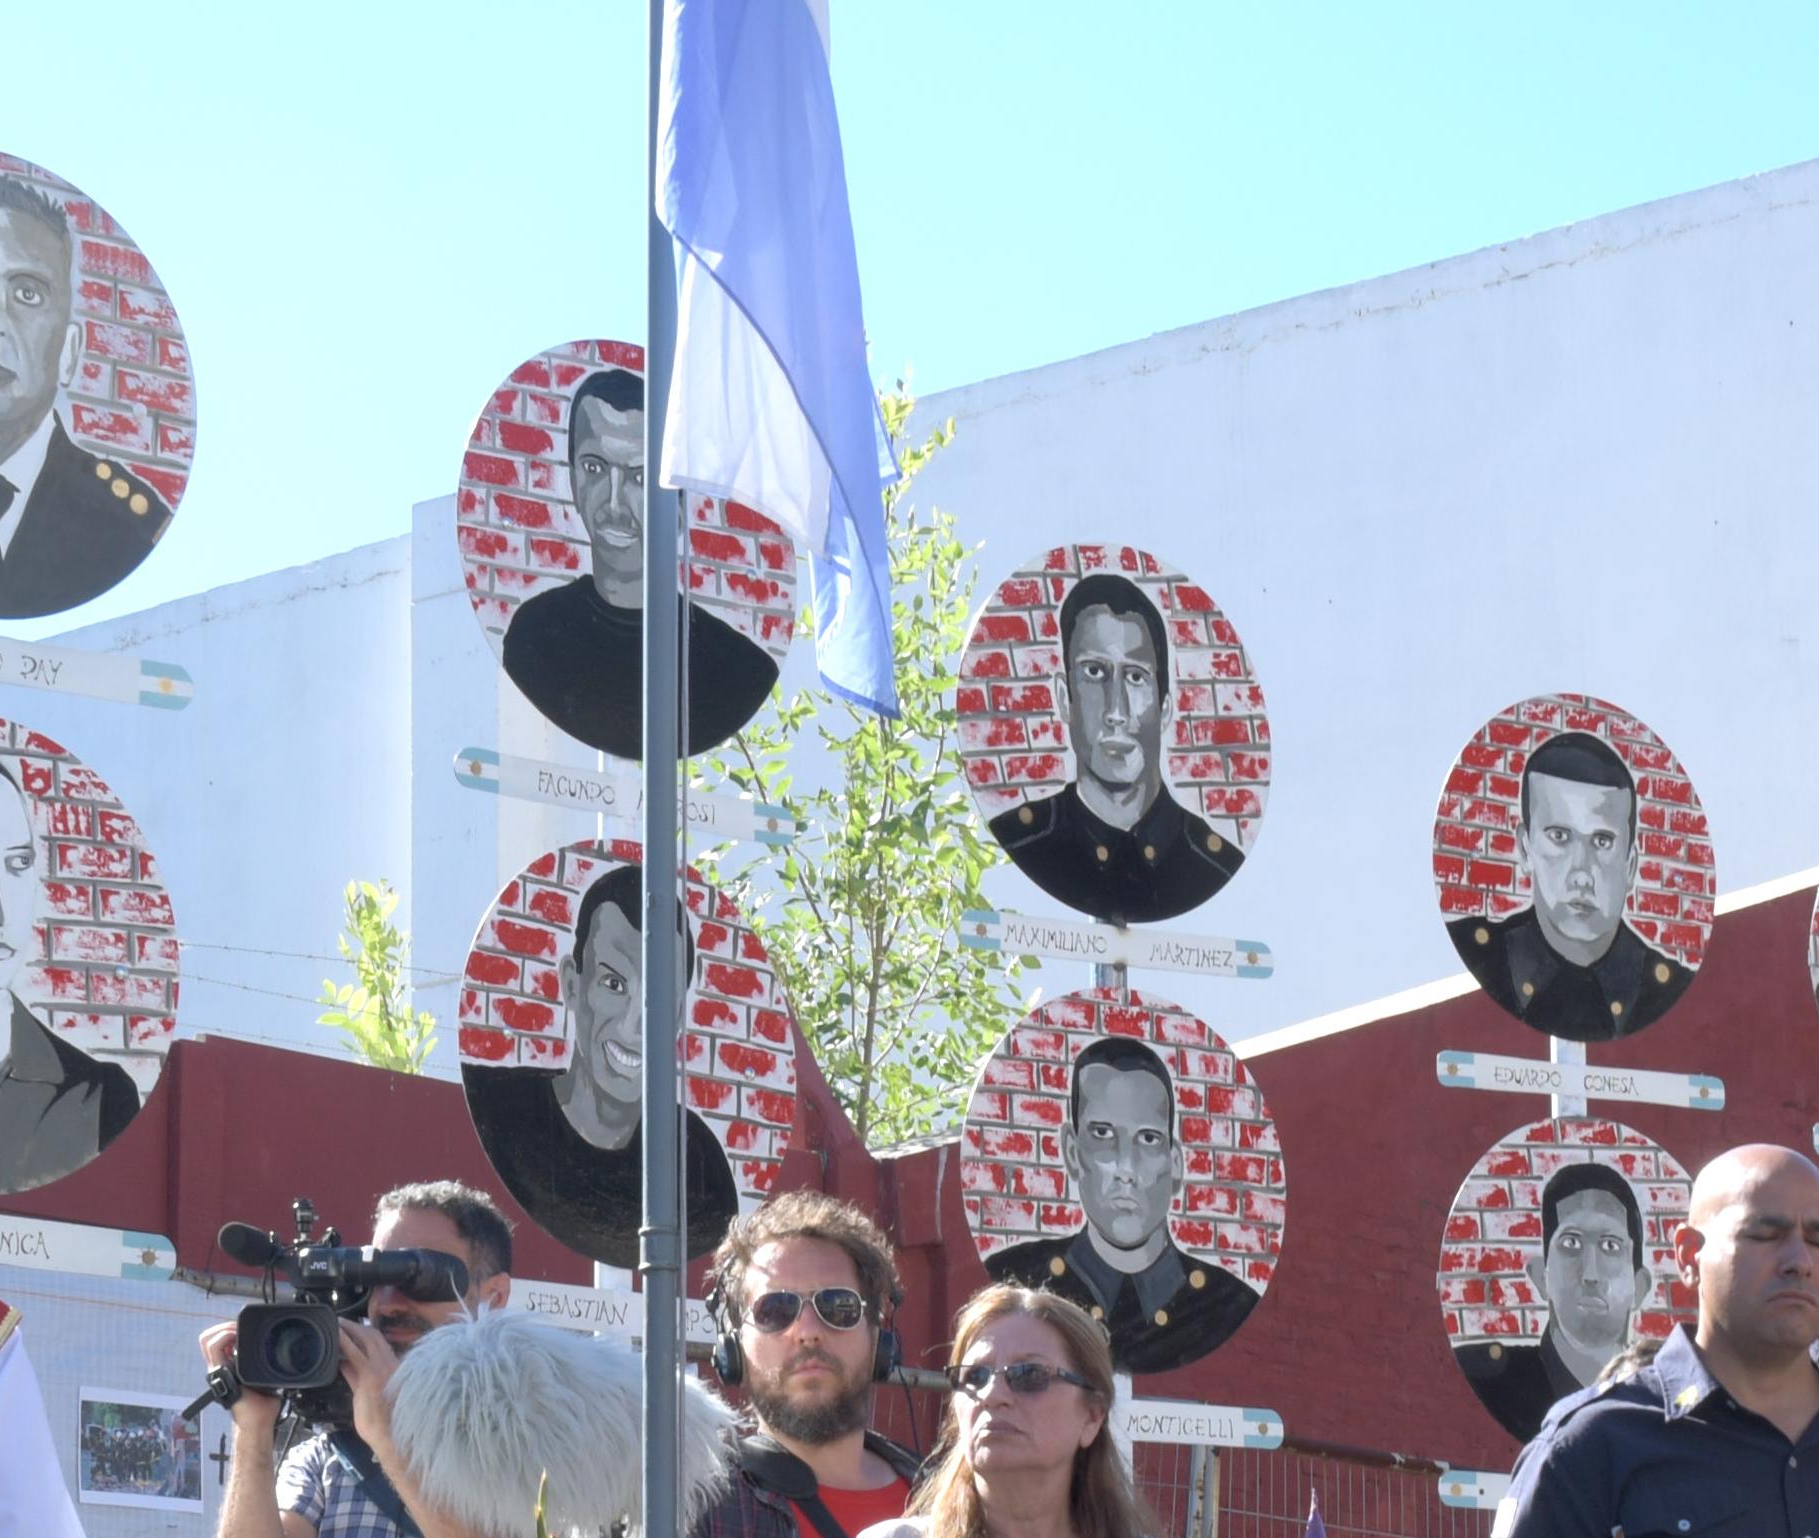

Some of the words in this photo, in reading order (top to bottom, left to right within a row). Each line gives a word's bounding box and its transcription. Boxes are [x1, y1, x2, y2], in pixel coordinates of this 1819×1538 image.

[21, 654, 64, 686] DAY
[537, 769, 616, 806] FACUNDO
[1003, 922, 1108, 954] MAXIMILIANO
[1149, 942, 1234, 969] MARTINEZ
[1493, 1065, 1562, 1089] EDUARDO
[1583, 1073, 1639, 1097] CONESA
[309, 1260, 328, 1271] JVC
[524, 1291, 629, 1327] SEBASTIAN
[1125, 1412, 1236, 1440] MONTICELLI
